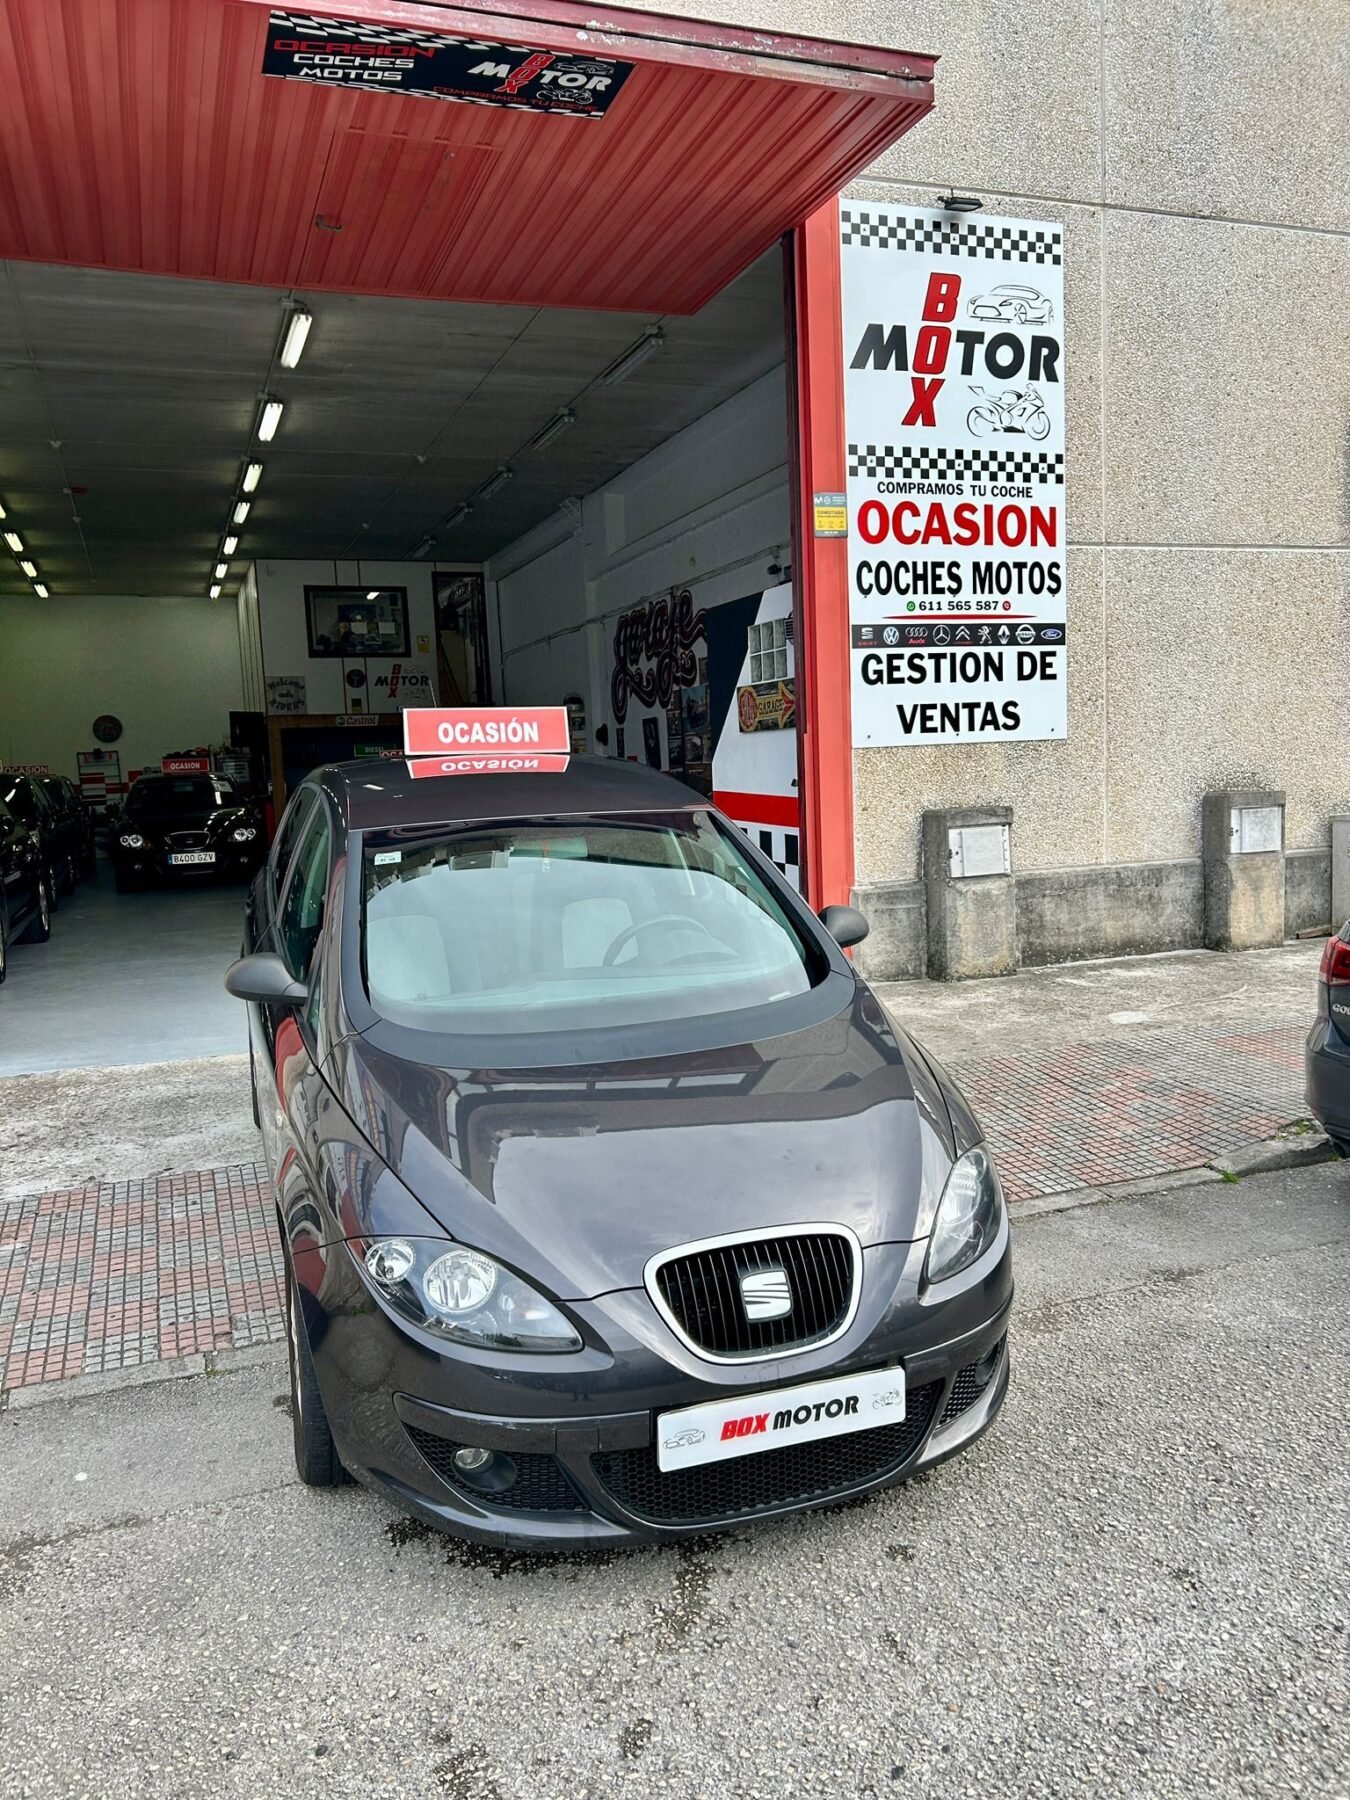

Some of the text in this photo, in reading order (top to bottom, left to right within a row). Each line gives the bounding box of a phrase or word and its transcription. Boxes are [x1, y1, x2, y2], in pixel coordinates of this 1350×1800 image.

[273, 39, 436, 58] OCASION
[292, 53, 415, 68] COCHES
[299, 66, 402, 81] MOTOS
[432, 86, 527, 103] COMPRAMOS
[849, 323, 1060, 383] MOTOR
[901, 272, 962, 427] BOX
[877, 481, 1033, 498] COMPRAMOS TU COCHE
[857, 500, 1057, 547] OCASION
[856, 560, 1062, 596] COCHES MOTOS
[919, 601, 999, 611] 611 565 587
[861, 651, 1057, 686] GESTION DE
[757, 698, 784, 715] GARAGE
[346, 716, 376, 725] Castrol
[896, 700, 1021, 735] VENTAS
[437, 717, 539, 744] OCASIÓN
[173, 853, 213, 863] 8400 GZV
[720, 1395, 859, 1441] BOX MOTOR
